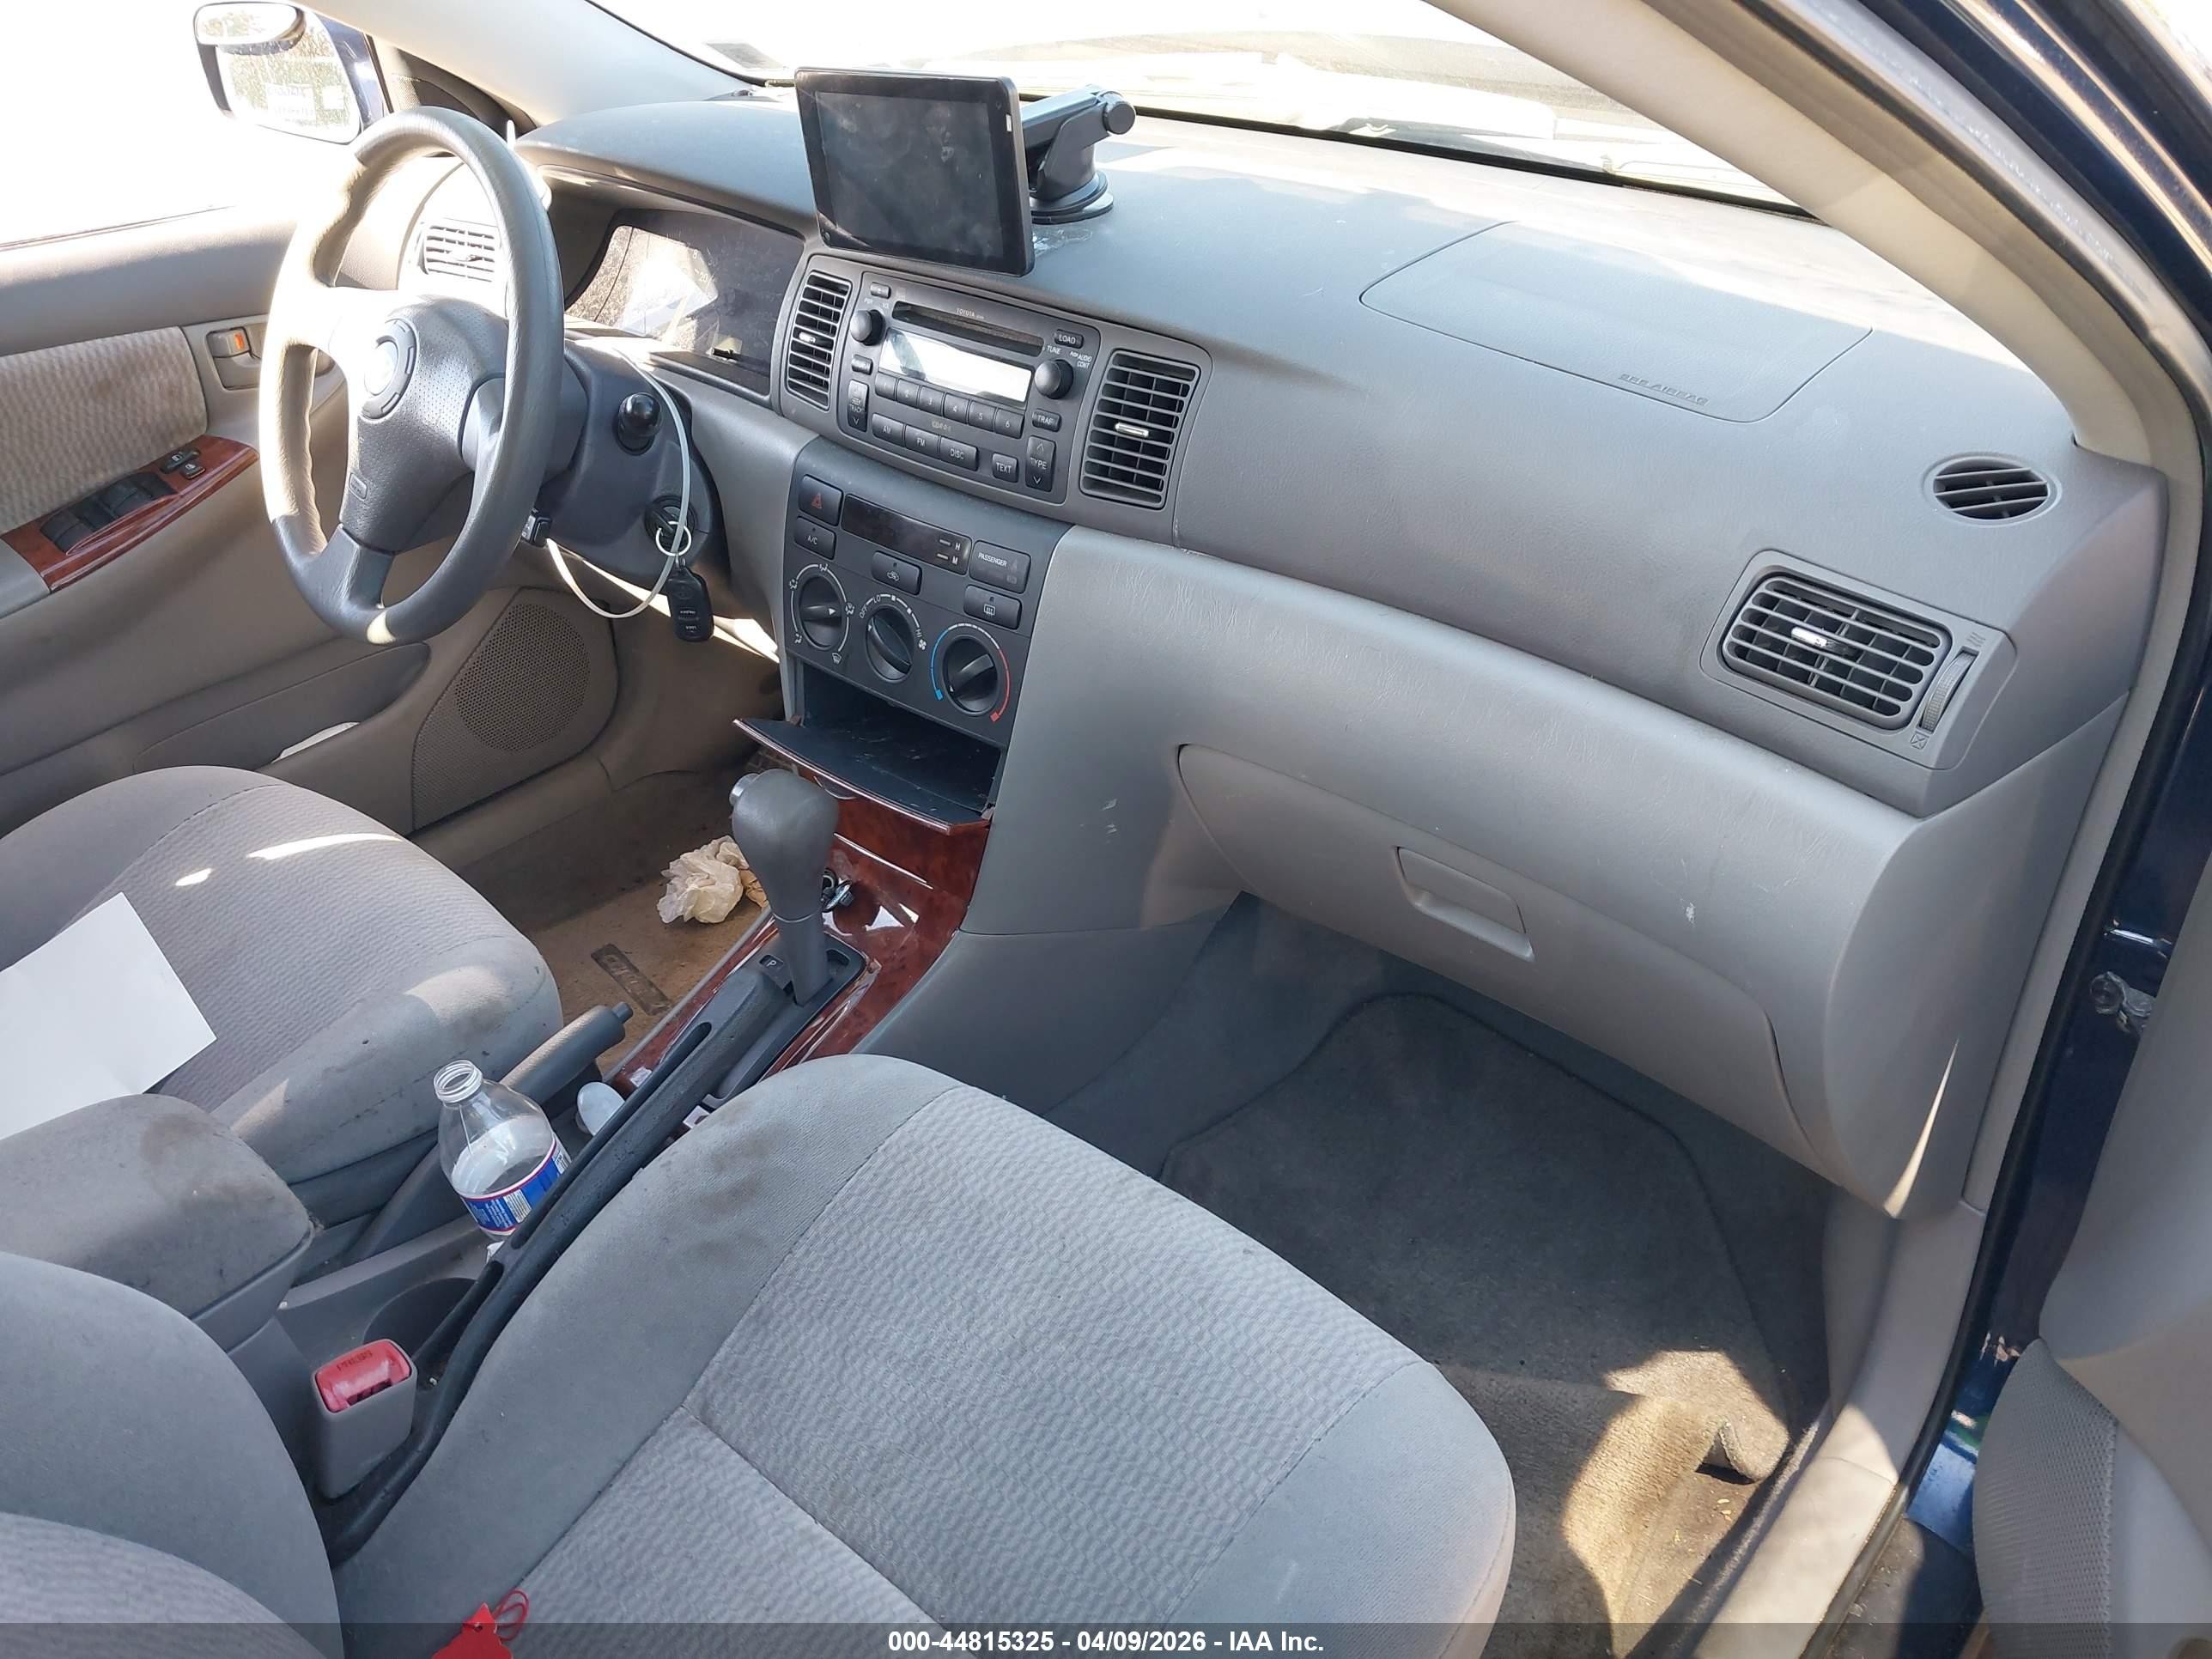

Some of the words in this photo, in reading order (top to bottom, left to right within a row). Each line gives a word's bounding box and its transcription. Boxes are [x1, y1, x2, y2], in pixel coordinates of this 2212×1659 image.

[956, 307, 976, 318] TOYOTA
[1058, 334, 1077, 344] LOAD
[1047, 344, 1061, 355] TUNE
[1077, 361, 1091, 369] CONT
[1005, 419, 1011, 428] 6
[1036, 414, 1054, 425] TRAF
[882, 424, 892, 434] AM
[916, 437, 926, 447] FM
[950, 447, 964, 460] DISC
[996, 461, 1012, 474] TEXT
[1030, 457, 1048, 471] TYPE
[807, 535, 817, 545] A/C
[955, 542, 961, 551] H
[951, 556, 958, 565] M
[978, 551, 1007, 567] PASSENGER
[859, 604, 867, 619] OFF
[915, 629, 922, 638] HI
